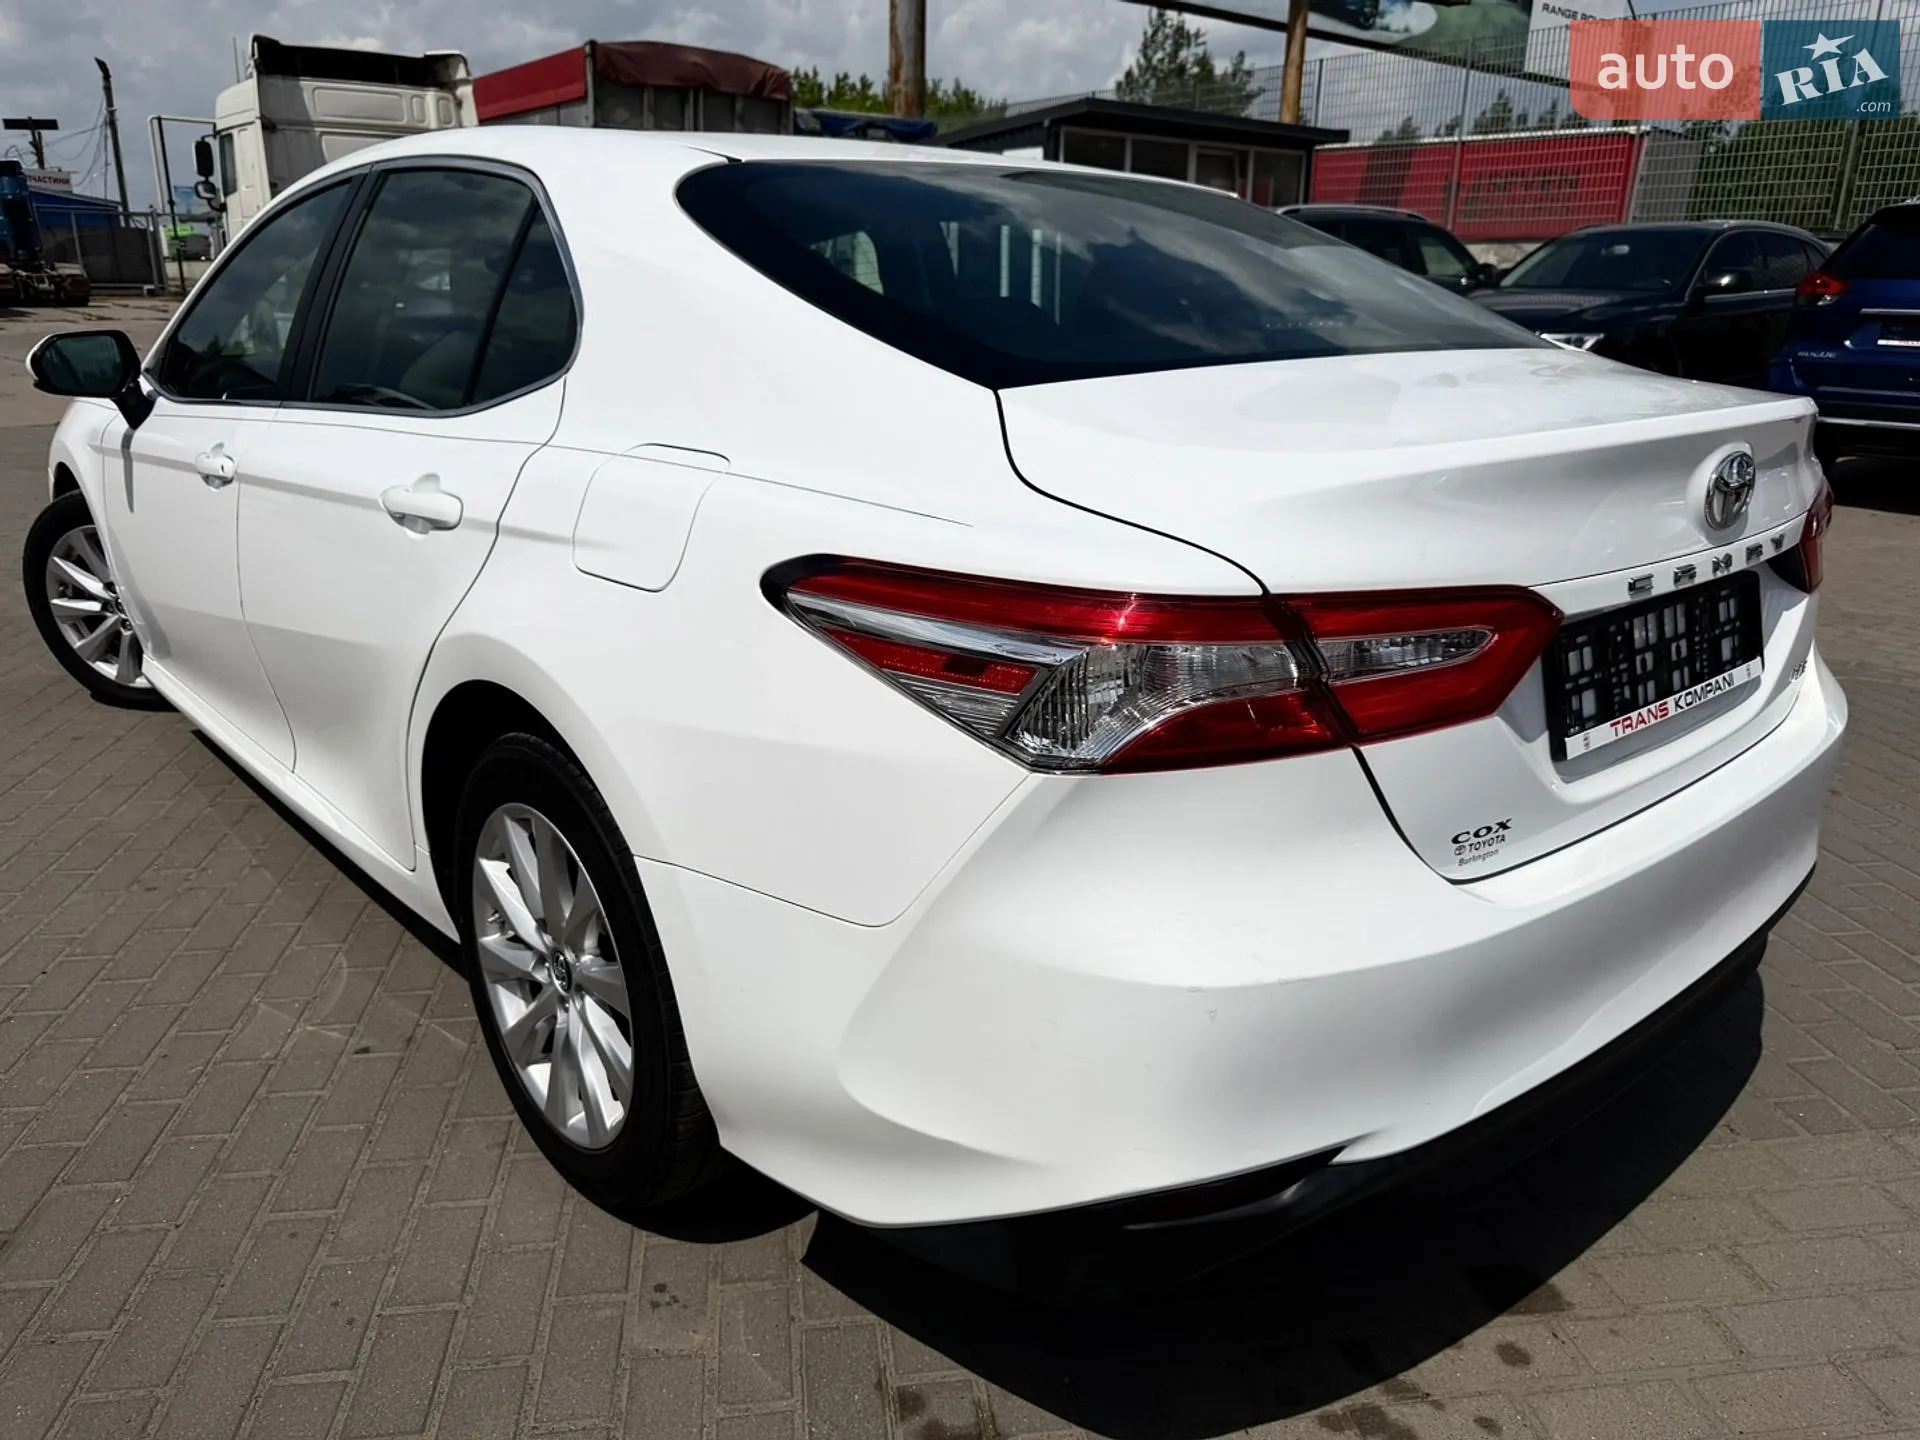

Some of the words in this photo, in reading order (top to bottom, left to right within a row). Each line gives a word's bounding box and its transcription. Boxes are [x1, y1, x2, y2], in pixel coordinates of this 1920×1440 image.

[1541, 3, 1579, 20] RANGE
[1627, 533, 1786, 595] CAMRY
[1609, 700, 1671, 738] TRANS
[1673, 672, 1736, 713] KOMPANI
[1450, 817, 1513, 845] COX
[1468, 834, 1506, 853] TOYOTA
[1457, 848, 1499, 867] Burlington
